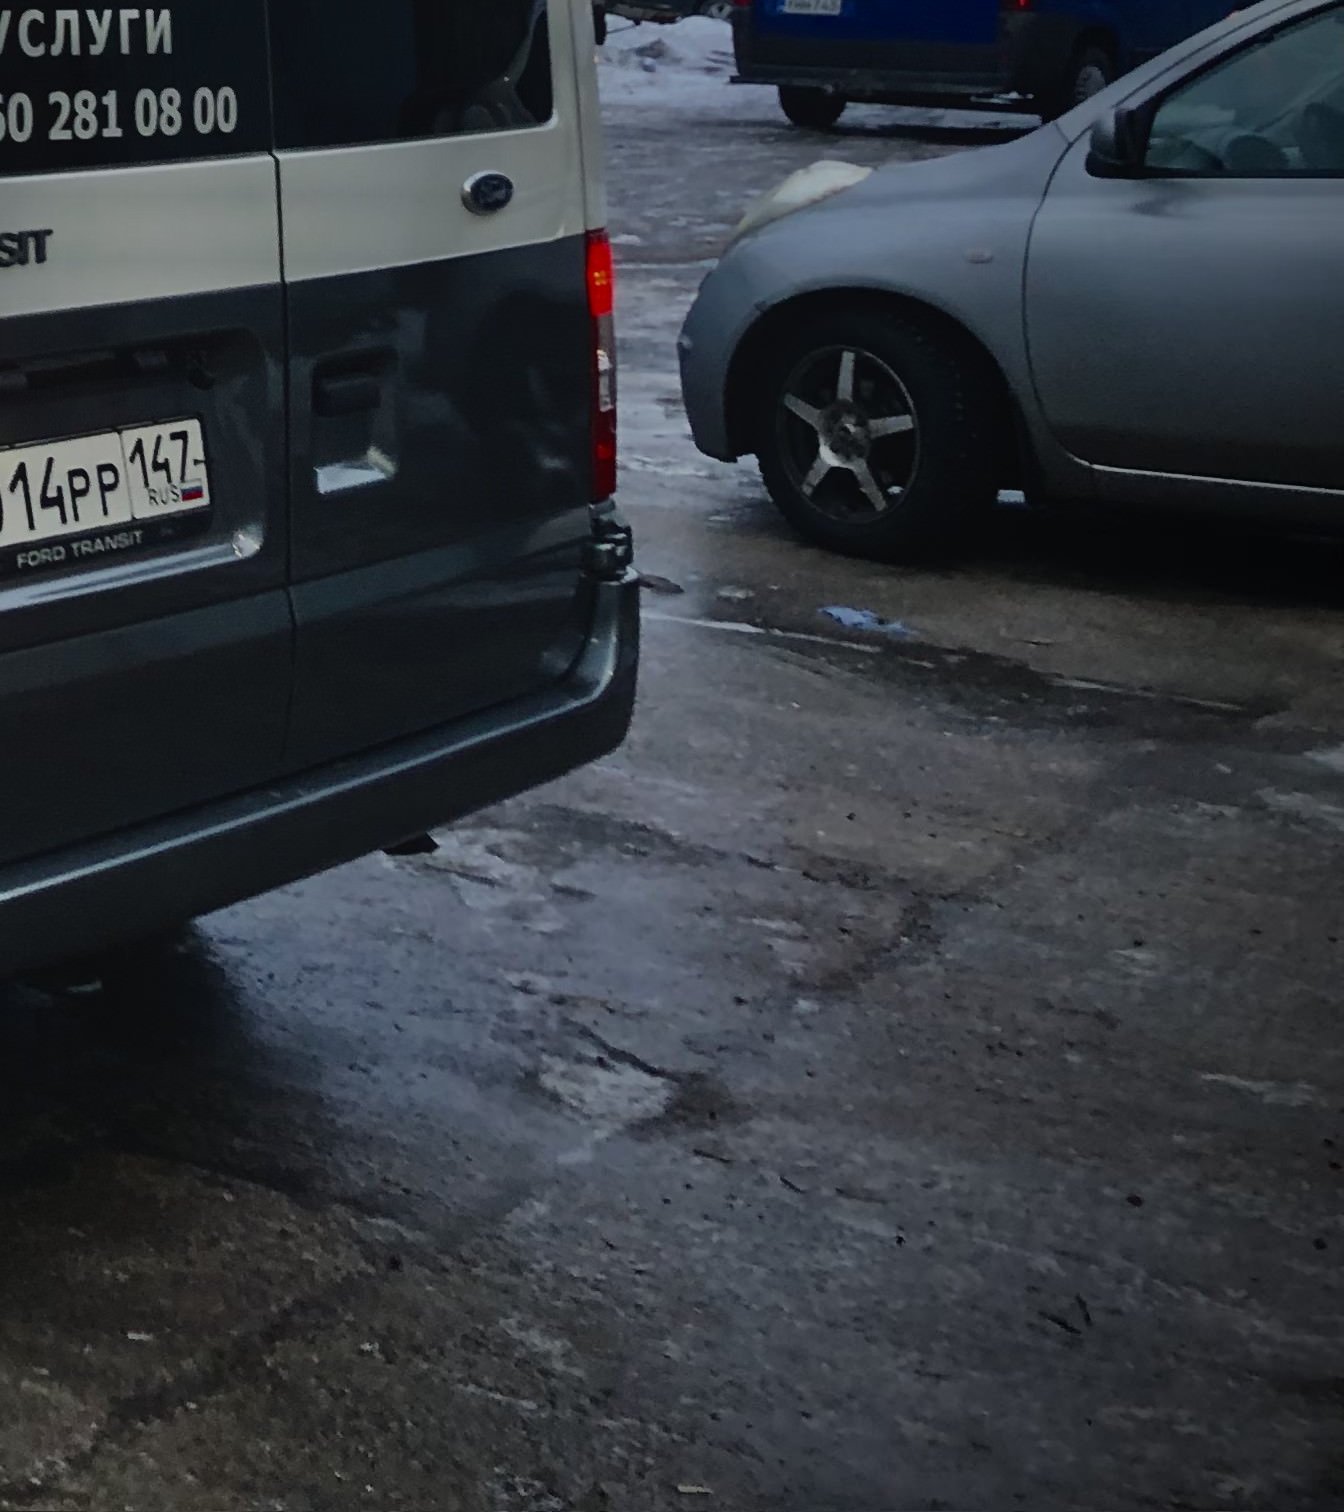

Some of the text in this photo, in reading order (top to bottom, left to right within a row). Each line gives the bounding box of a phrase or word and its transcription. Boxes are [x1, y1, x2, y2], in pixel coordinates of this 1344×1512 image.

[48, 88, 123, 141] 281
[134, 87, 183, 138] 08
[193, 86, 238, 135] 00
[129, 430, 188, 488] 147
[148, 486, 180, 506] RUS
[16, 530, 144, 569] FORD TRANSIT
